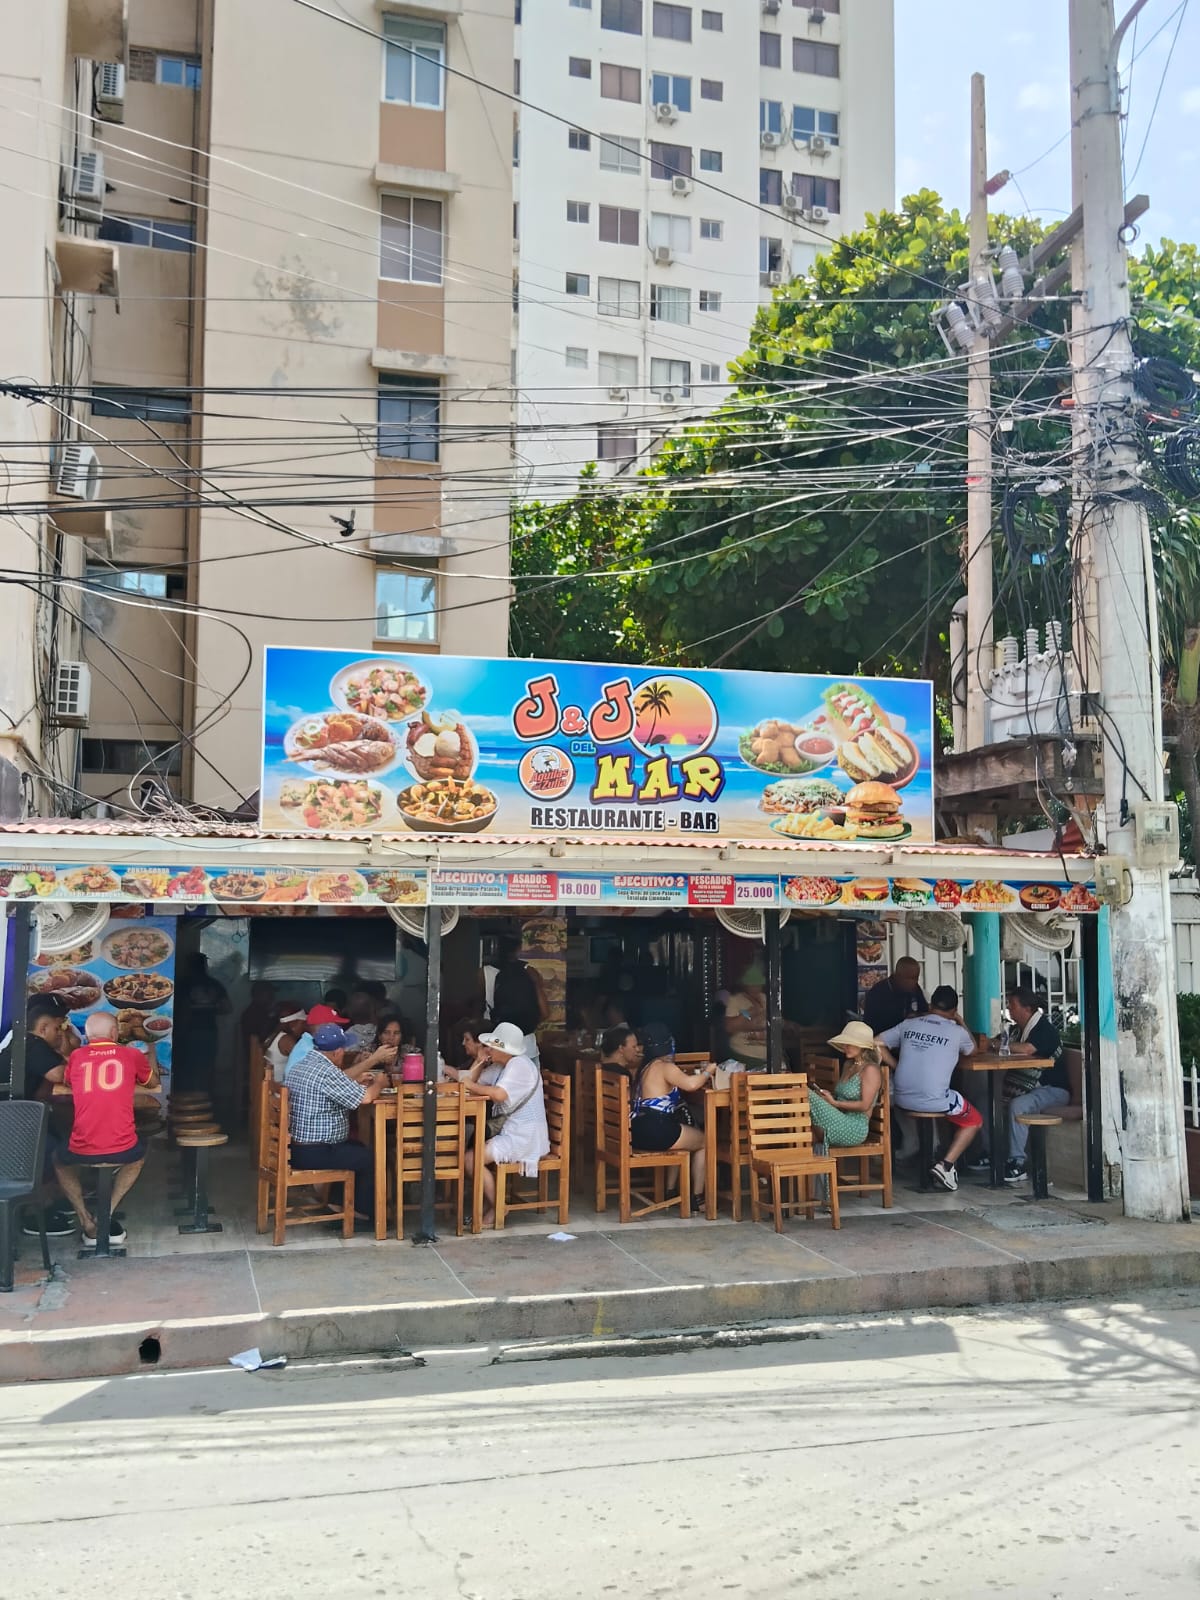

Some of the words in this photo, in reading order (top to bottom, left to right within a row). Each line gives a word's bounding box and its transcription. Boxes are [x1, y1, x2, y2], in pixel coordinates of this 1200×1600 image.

[514, 675, 558, 738] J
[561, 706, 588, 735] &
[590, 678, 634, 741] J
[572, 741, 596, 754] DEL
[592, 754, 723, 801] MAR
[531, 807, 663, 829] RESTAURANTE
[680, 812, 717, 831] BAR
[431, 872, 496, 884] EJECUTIVO
[498, 873, 504, 884] 1
[512, 874, 548, 884] ASADOS
[614, 875, 674, 887] EJECUTIVO
[676, 877, 684, 887] 2
[690, 876, 733, 885] PESCADOS
[560, 883, 597, 895] 18.000
[737, 887, 772, 898] 25.000
[81, 1059, 123, 1093] 10
